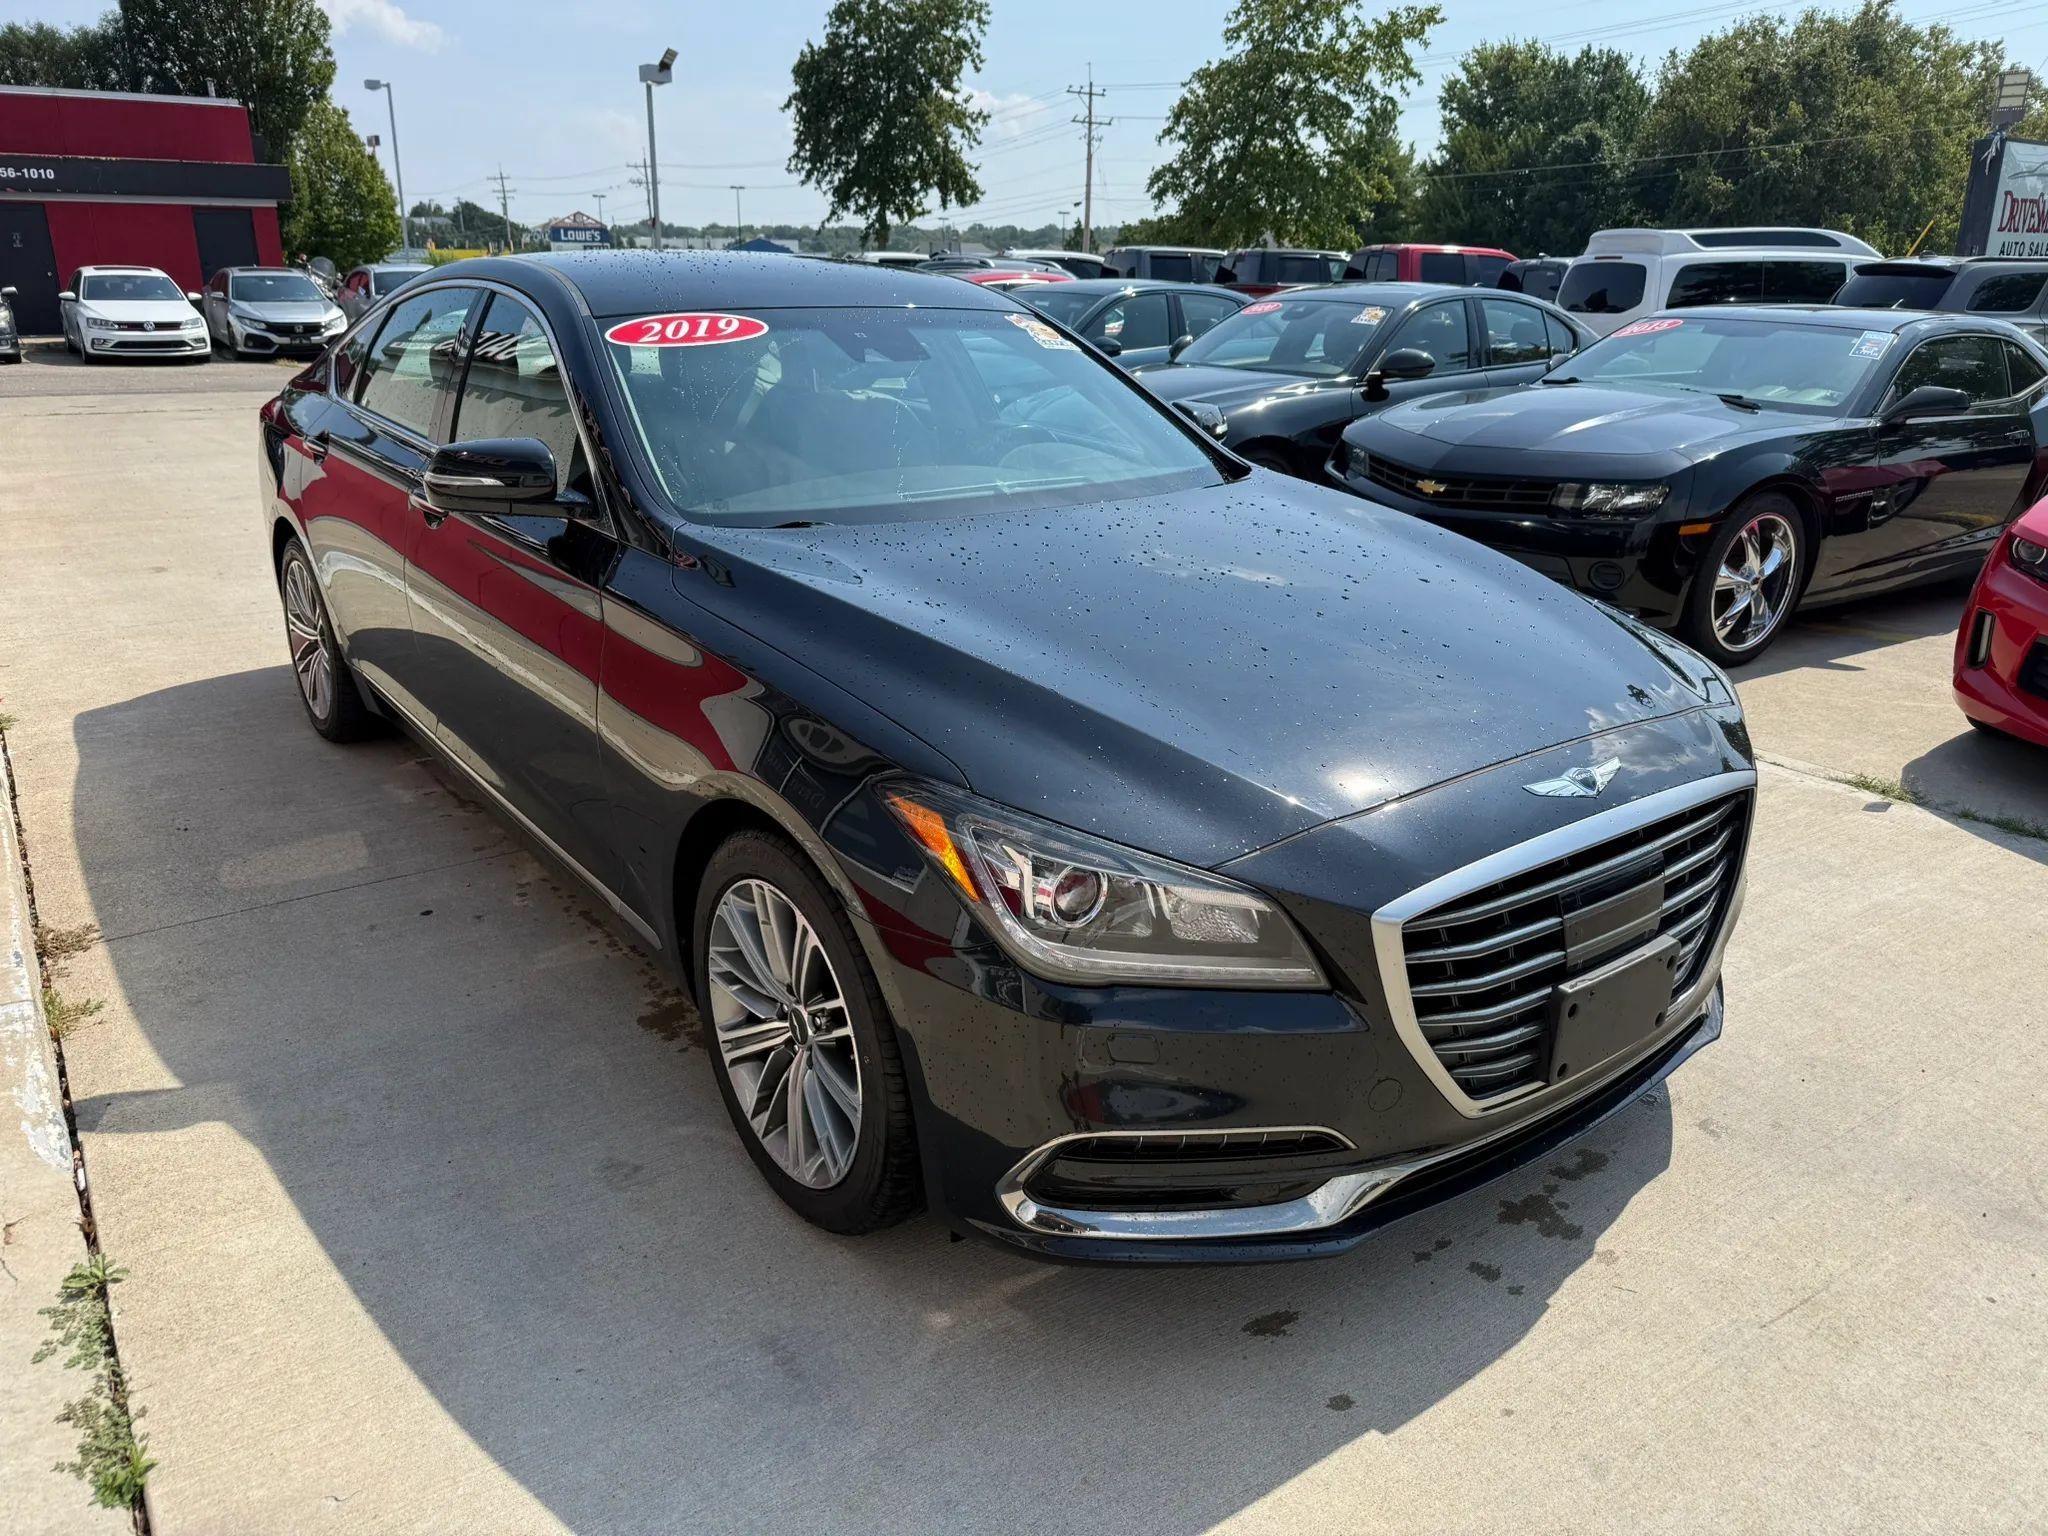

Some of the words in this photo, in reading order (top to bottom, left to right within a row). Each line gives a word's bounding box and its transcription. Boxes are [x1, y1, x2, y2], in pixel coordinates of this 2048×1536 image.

[0, 167, 55, 179] 56-1010
[560, 228, 601, 241] LOWE'S
[1999, 241, 2025, 257] AUTO
[637, 317, 741, 343] 2019
